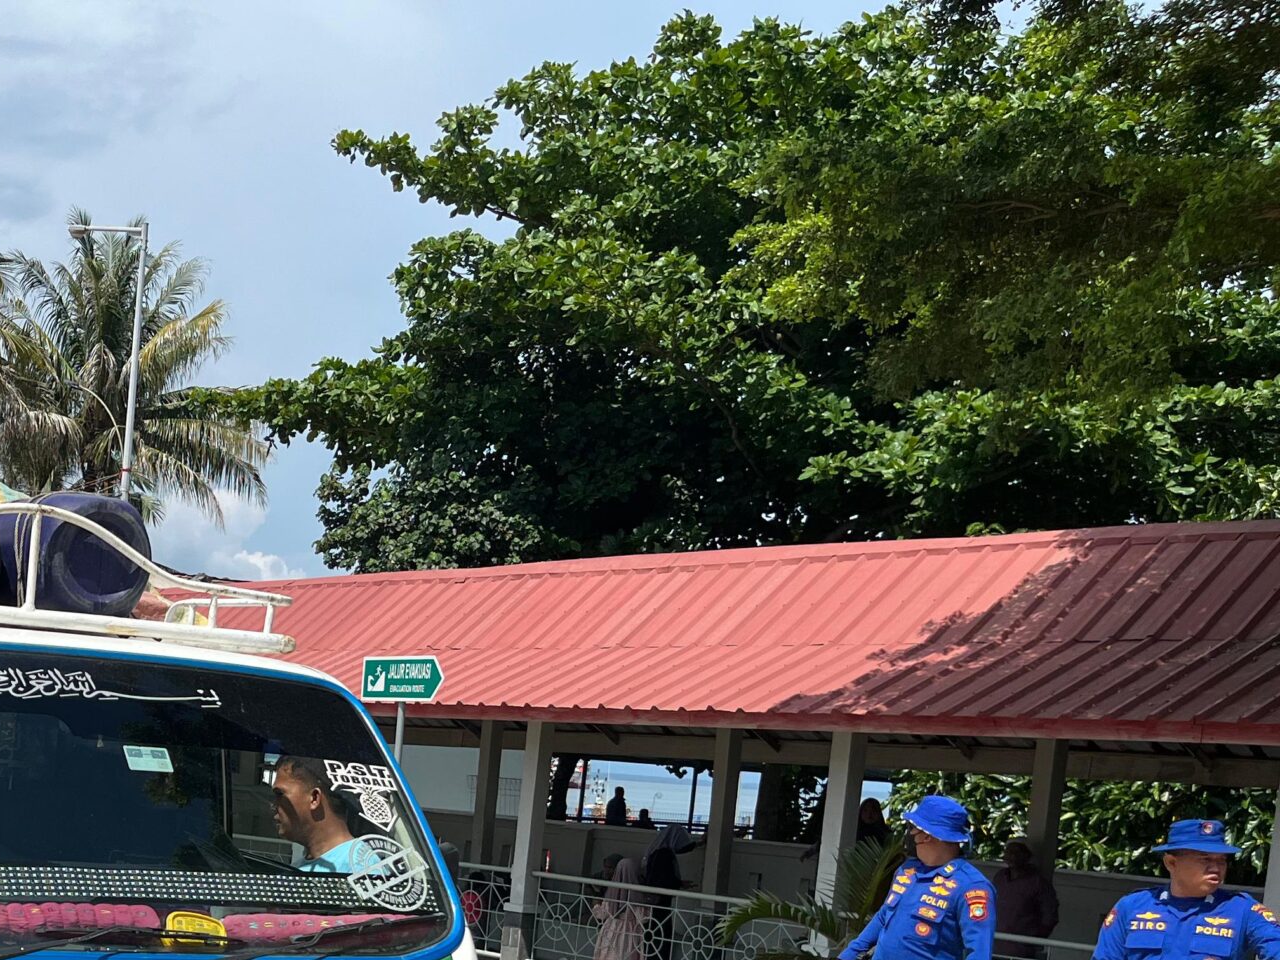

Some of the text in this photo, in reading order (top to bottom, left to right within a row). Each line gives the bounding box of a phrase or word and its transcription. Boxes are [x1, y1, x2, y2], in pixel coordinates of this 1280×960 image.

[387, 663, 432, 679] JALUR EVAKUASI
[329, 773, 395, 789] TOBOALI
[920, 894, 948, 909] POLRI
[1130, 920, 1167, 931] ZIRO
[1195, 925, 1233, 938] POLRI
